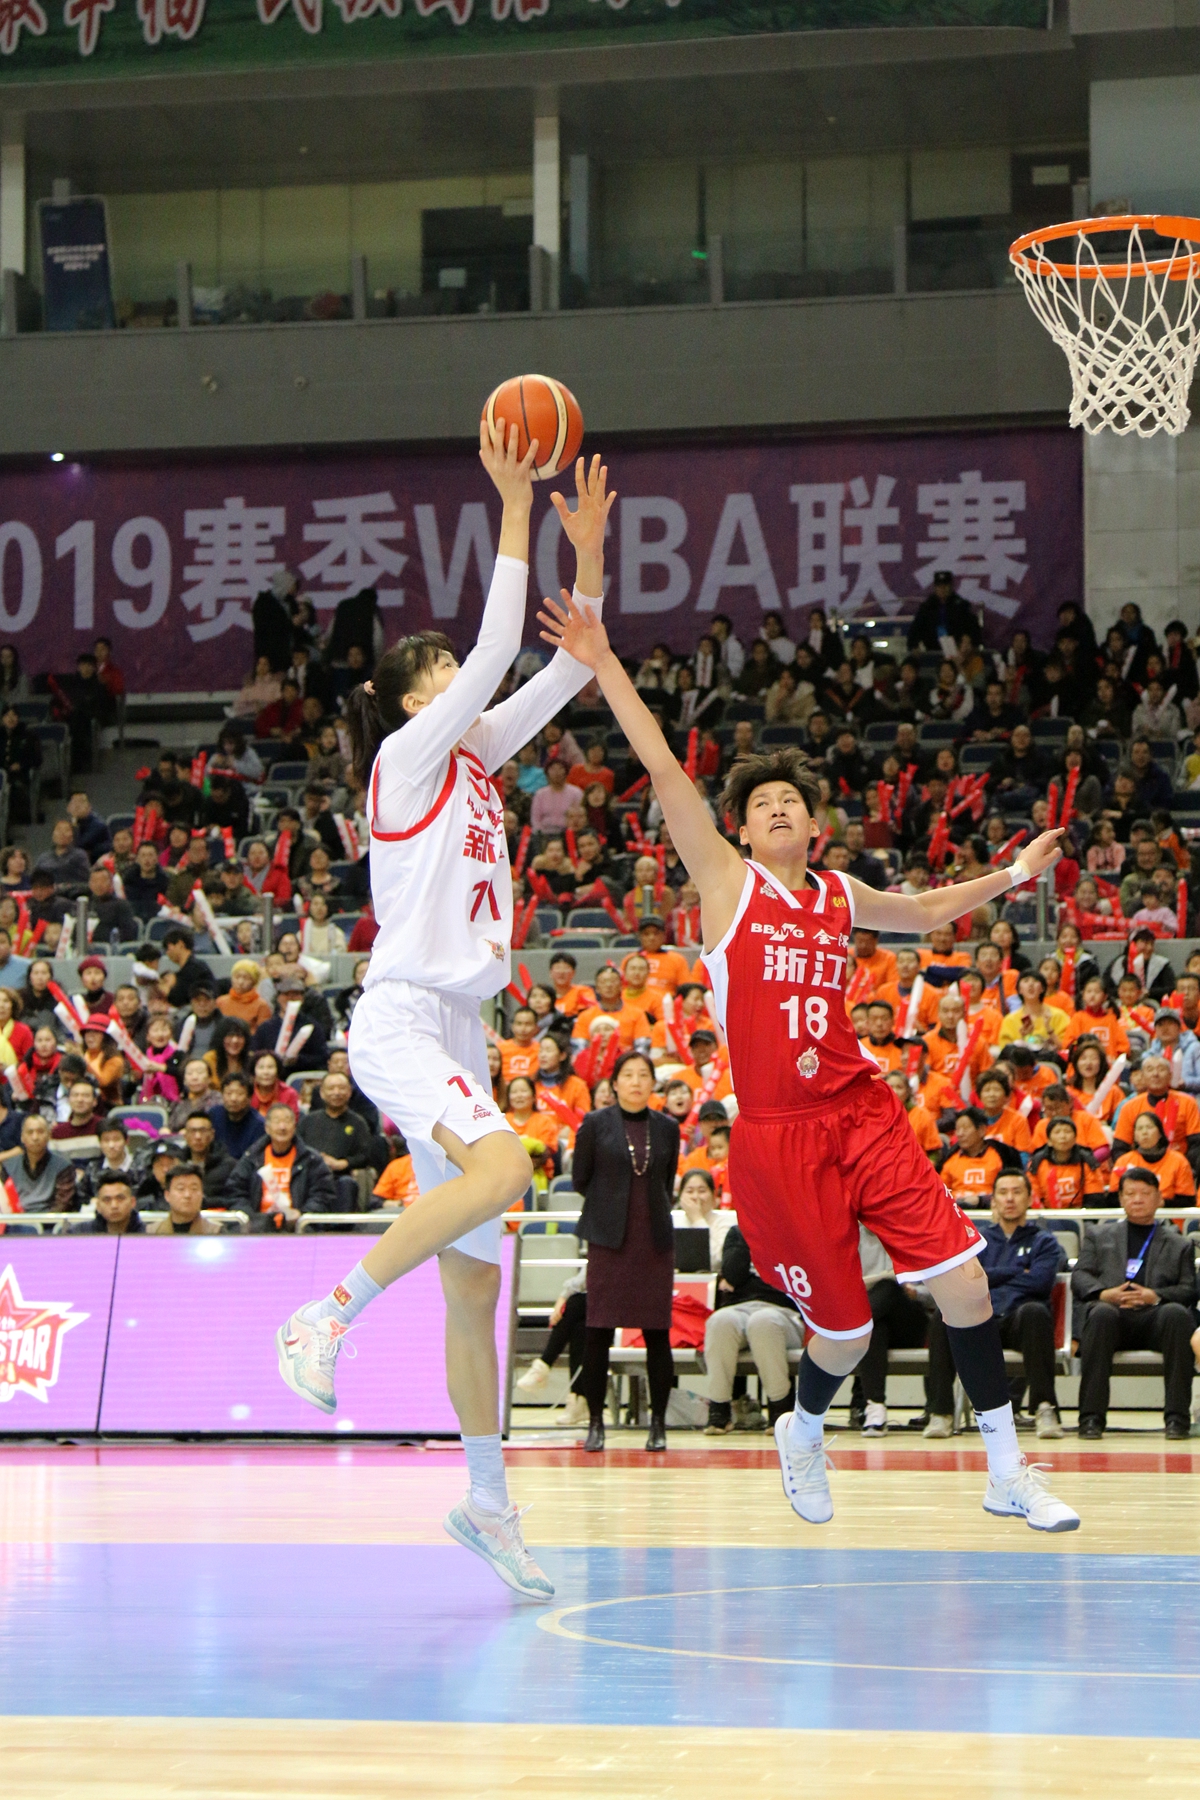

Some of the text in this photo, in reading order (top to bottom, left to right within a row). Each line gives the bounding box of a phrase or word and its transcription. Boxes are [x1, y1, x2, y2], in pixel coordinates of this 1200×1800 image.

[763, 944, 847, 991] 浙江
[780, 995, 829, 1040] 18
[774, 1263, 813, 1298] 18
